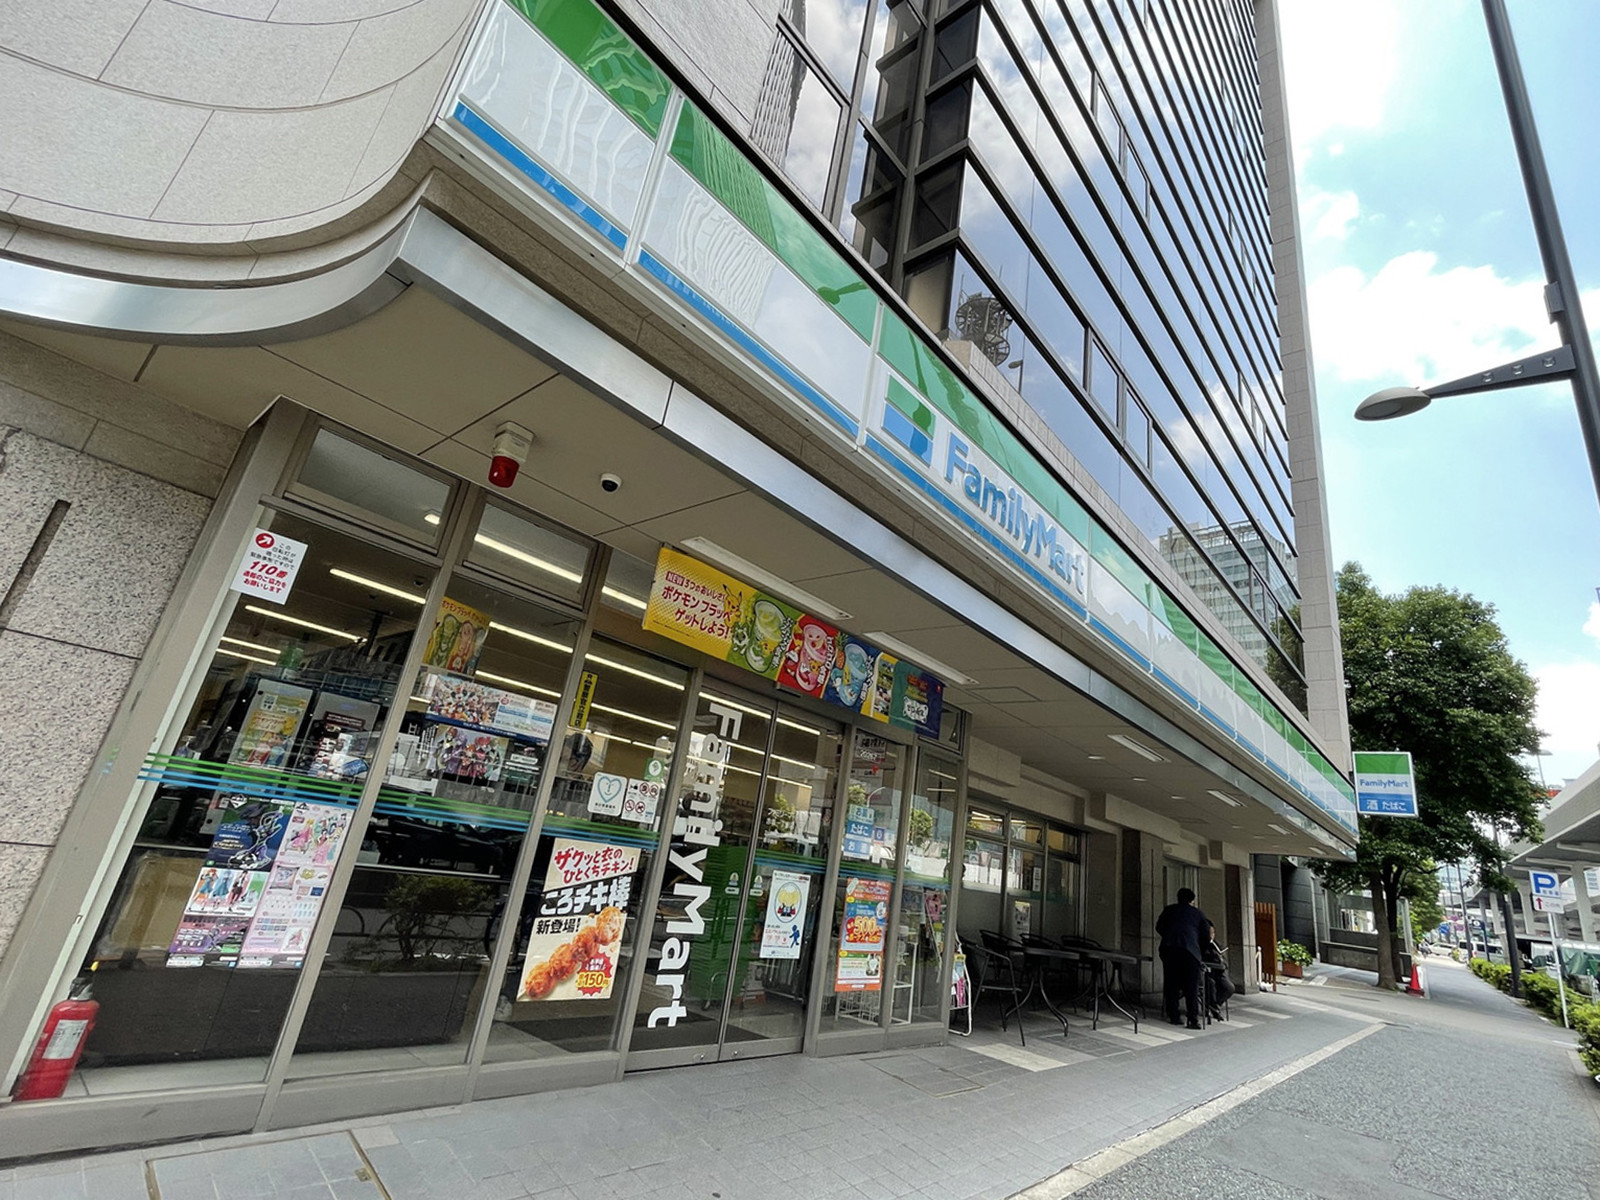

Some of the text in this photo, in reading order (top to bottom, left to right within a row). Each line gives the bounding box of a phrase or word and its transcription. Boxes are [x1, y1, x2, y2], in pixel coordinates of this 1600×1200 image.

[945, 431, 1084, 595] FamilyMart
[250, 560, 288, 579] 110番
[667, 571, 685, 587] NEW
[243, 578, 282, 594] お願いします
[675, 608, 730, 639] ゲットしよう!
[1360, 778, 1409, 789] FamilyMart
[1366, 799, 1407, 811] 酒 たばこ
[851, 823, 869, 836] たばこ
[554, 846, 623, 870] ザクッと衣の
[648, 702, 743, 1028] FamilyMart
[563, 857, 634, 884] ひとくちチキン!
[1532, 873, 1556, 893] P
[540, 875, 632, 915] ころチキ棒
[535, 918, 581, 935] 新登場!
